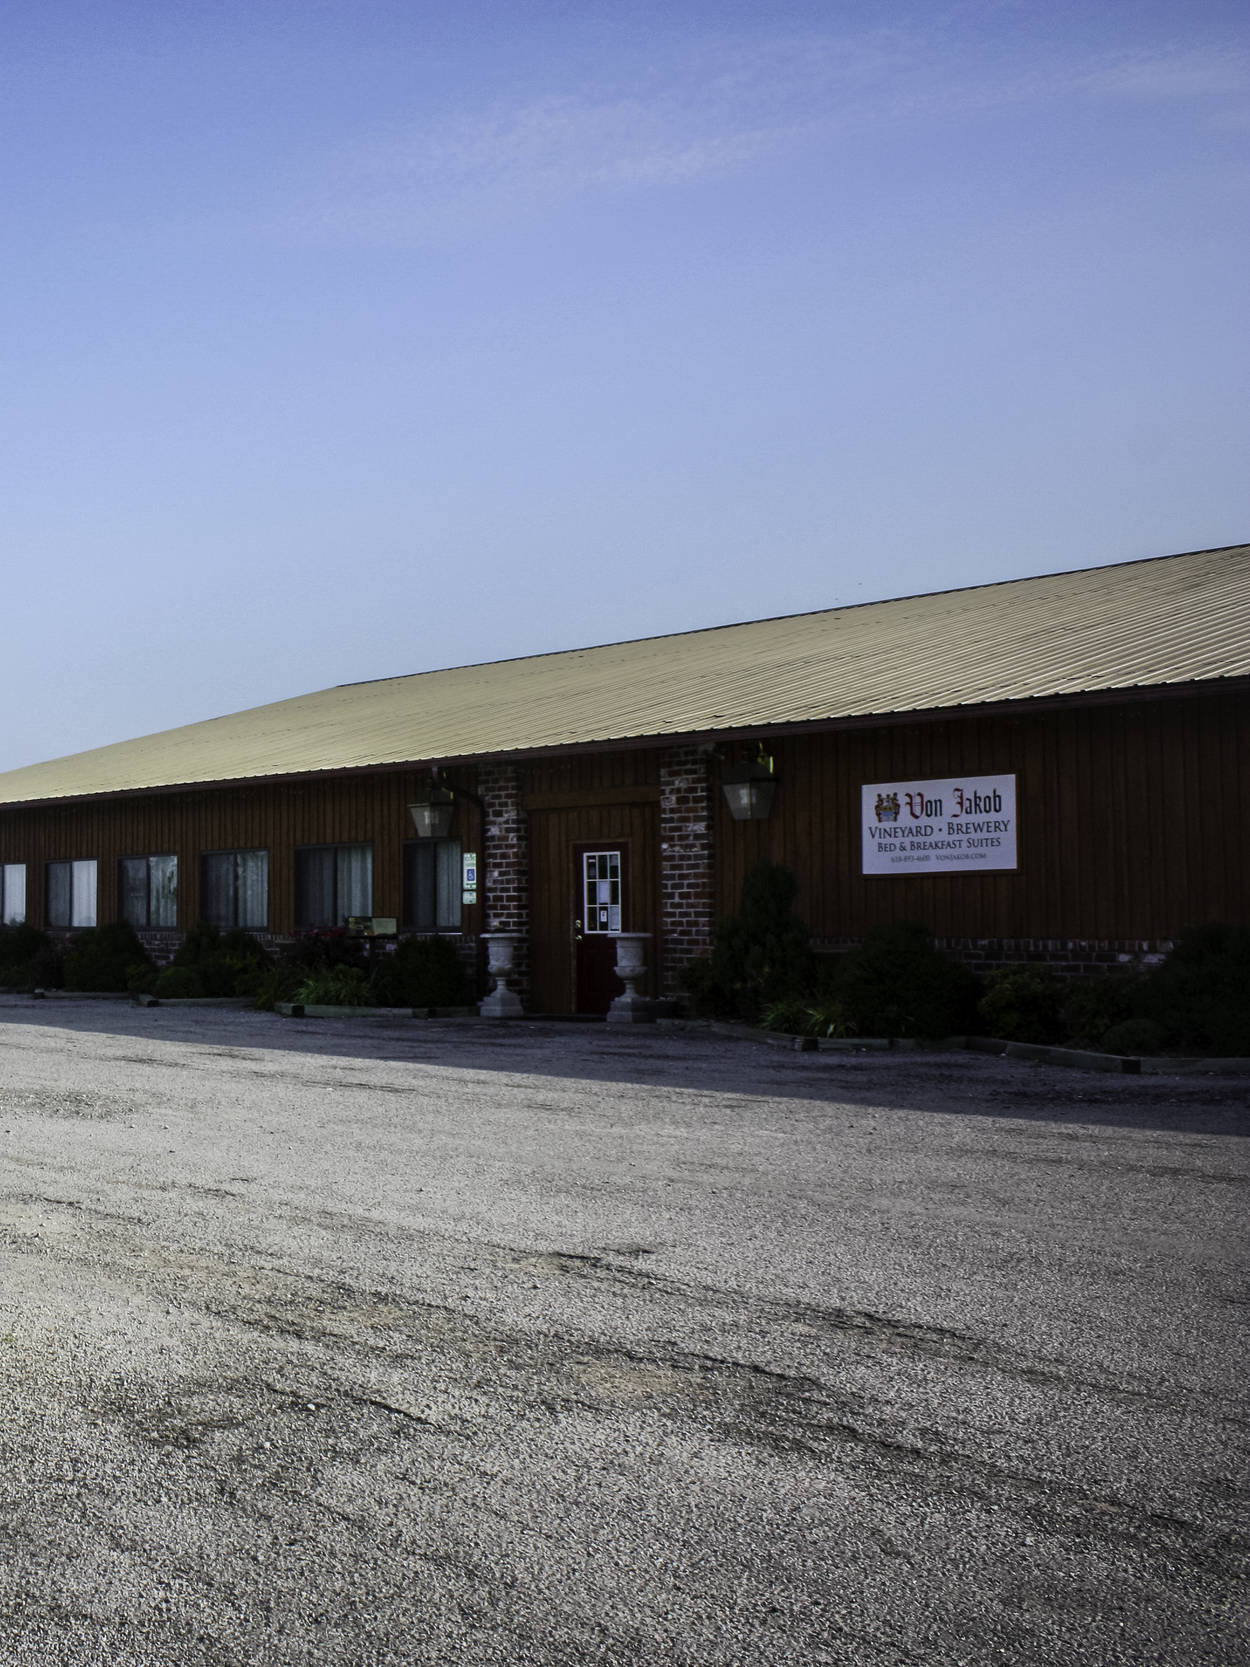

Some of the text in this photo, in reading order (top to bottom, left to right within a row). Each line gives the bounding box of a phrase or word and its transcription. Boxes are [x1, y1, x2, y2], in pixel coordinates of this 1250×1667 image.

[904, 788, 1002, 819] Von Jakob
[868, 820, 1011, 839] VINEYARD BREWERY
[877, 837, 1001, 852] BED & BREAKFAST SUITES
